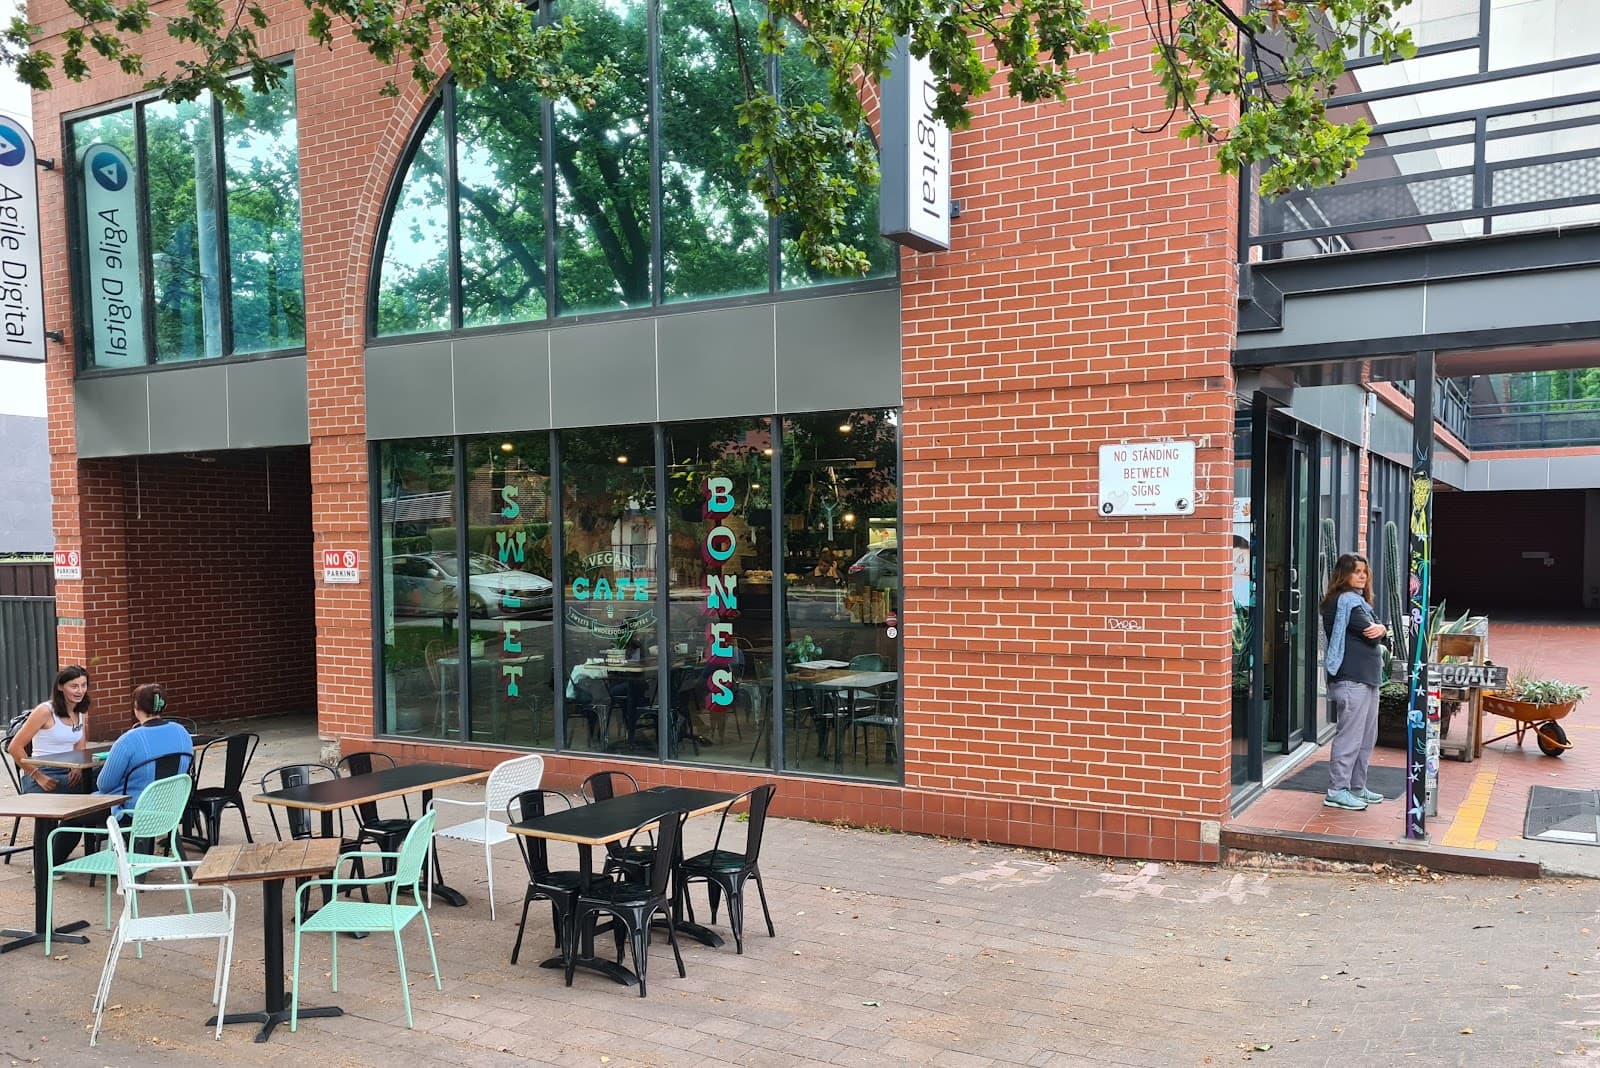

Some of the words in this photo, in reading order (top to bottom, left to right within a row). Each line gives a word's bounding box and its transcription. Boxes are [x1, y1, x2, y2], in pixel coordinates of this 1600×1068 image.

[917, 79, 941, 219] Digital
[0, 183, 26, 251] Agile
[0, 260, 33, 344] Digital
[1114, 451, 1127, 462] NO
[1132, 448, 1179, 462] STANDING
[1123, 467, 1169, 479] BETWEEN
[1131, 484, 1161, 496] SIGNS
[55, 553, 66, 565] NO
[325, 553, 340, 566] NO
[588, 552, 631, 567] VEGAN
[326, 569, 356, 577] PARKING
[495, 485, 527, 698] SWEET
[573, 577, 649, 601] CAFE
[703, 477, 738, 711] BONES
